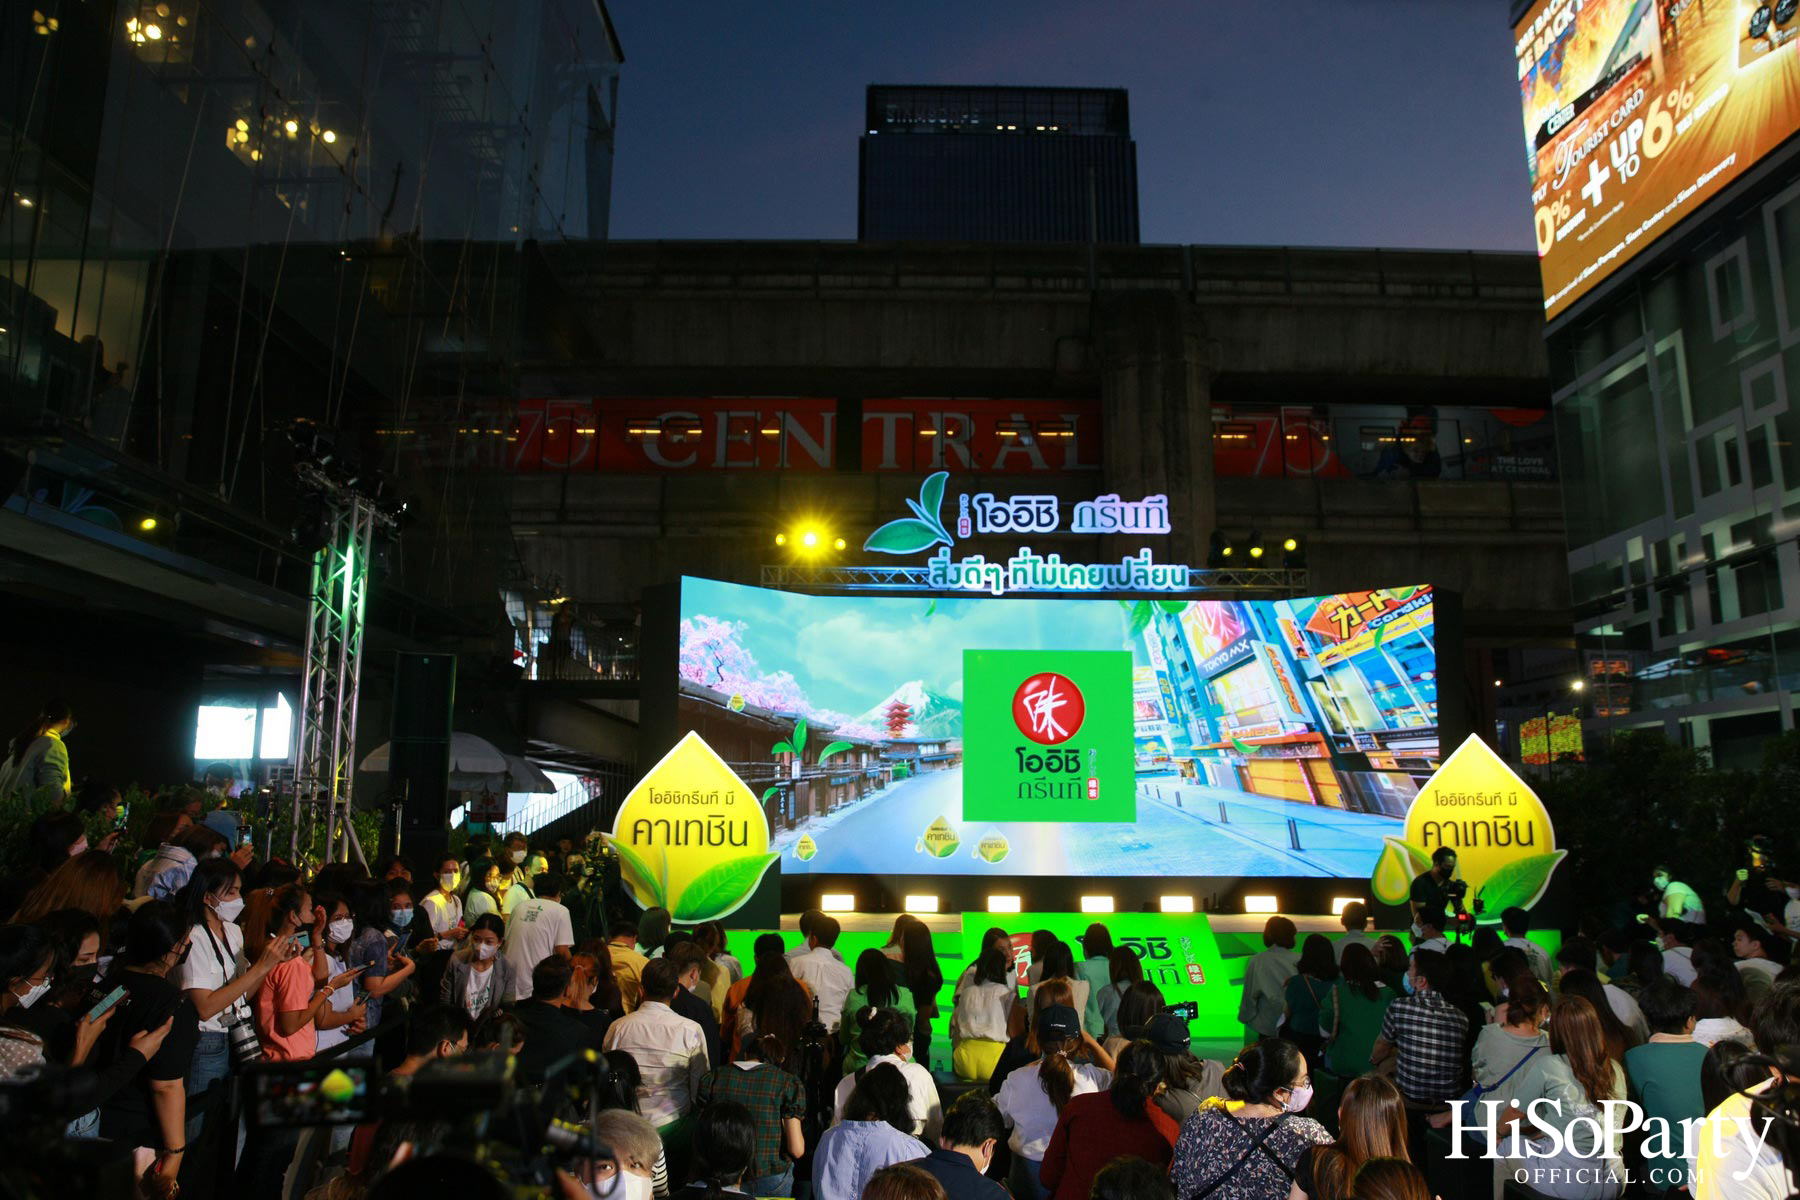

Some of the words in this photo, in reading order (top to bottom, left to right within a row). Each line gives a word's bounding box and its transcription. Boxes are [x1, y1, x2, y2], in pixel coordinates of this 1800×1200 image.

[1611, 88, 1645, 128] CARD
[1610, 118, 1644, 168] UP
[1617, 154, 1640, 185] TO
[975, 494, 1058, 531] โออิชิ
[1075, 494, 1167, 531] กรีนที
[930, 549, 1003, 592] สิ่งดีๆ
[1012, 549, 1187, 588] ที่ไม่เคยเปลี่ยน
[1203, 653, 1230, 674] TOKYO
[1229, 638, 1251, 659] MX
[1015, 746, 1082, 774] โออิชิ
[648, 787, 720, 806] โออิชิกรีนที
[725, 790, 735, 806] มี
[1017, 776, 1083, 800] กรีนที
[1434, 790, 1503, 807] โออิชิกรีนที
[1508, 790, 1518, 807] มี
[632, 814, 749, 847] คาเทชิน
[1422, 815, 1535, 848] คาเทชิน
